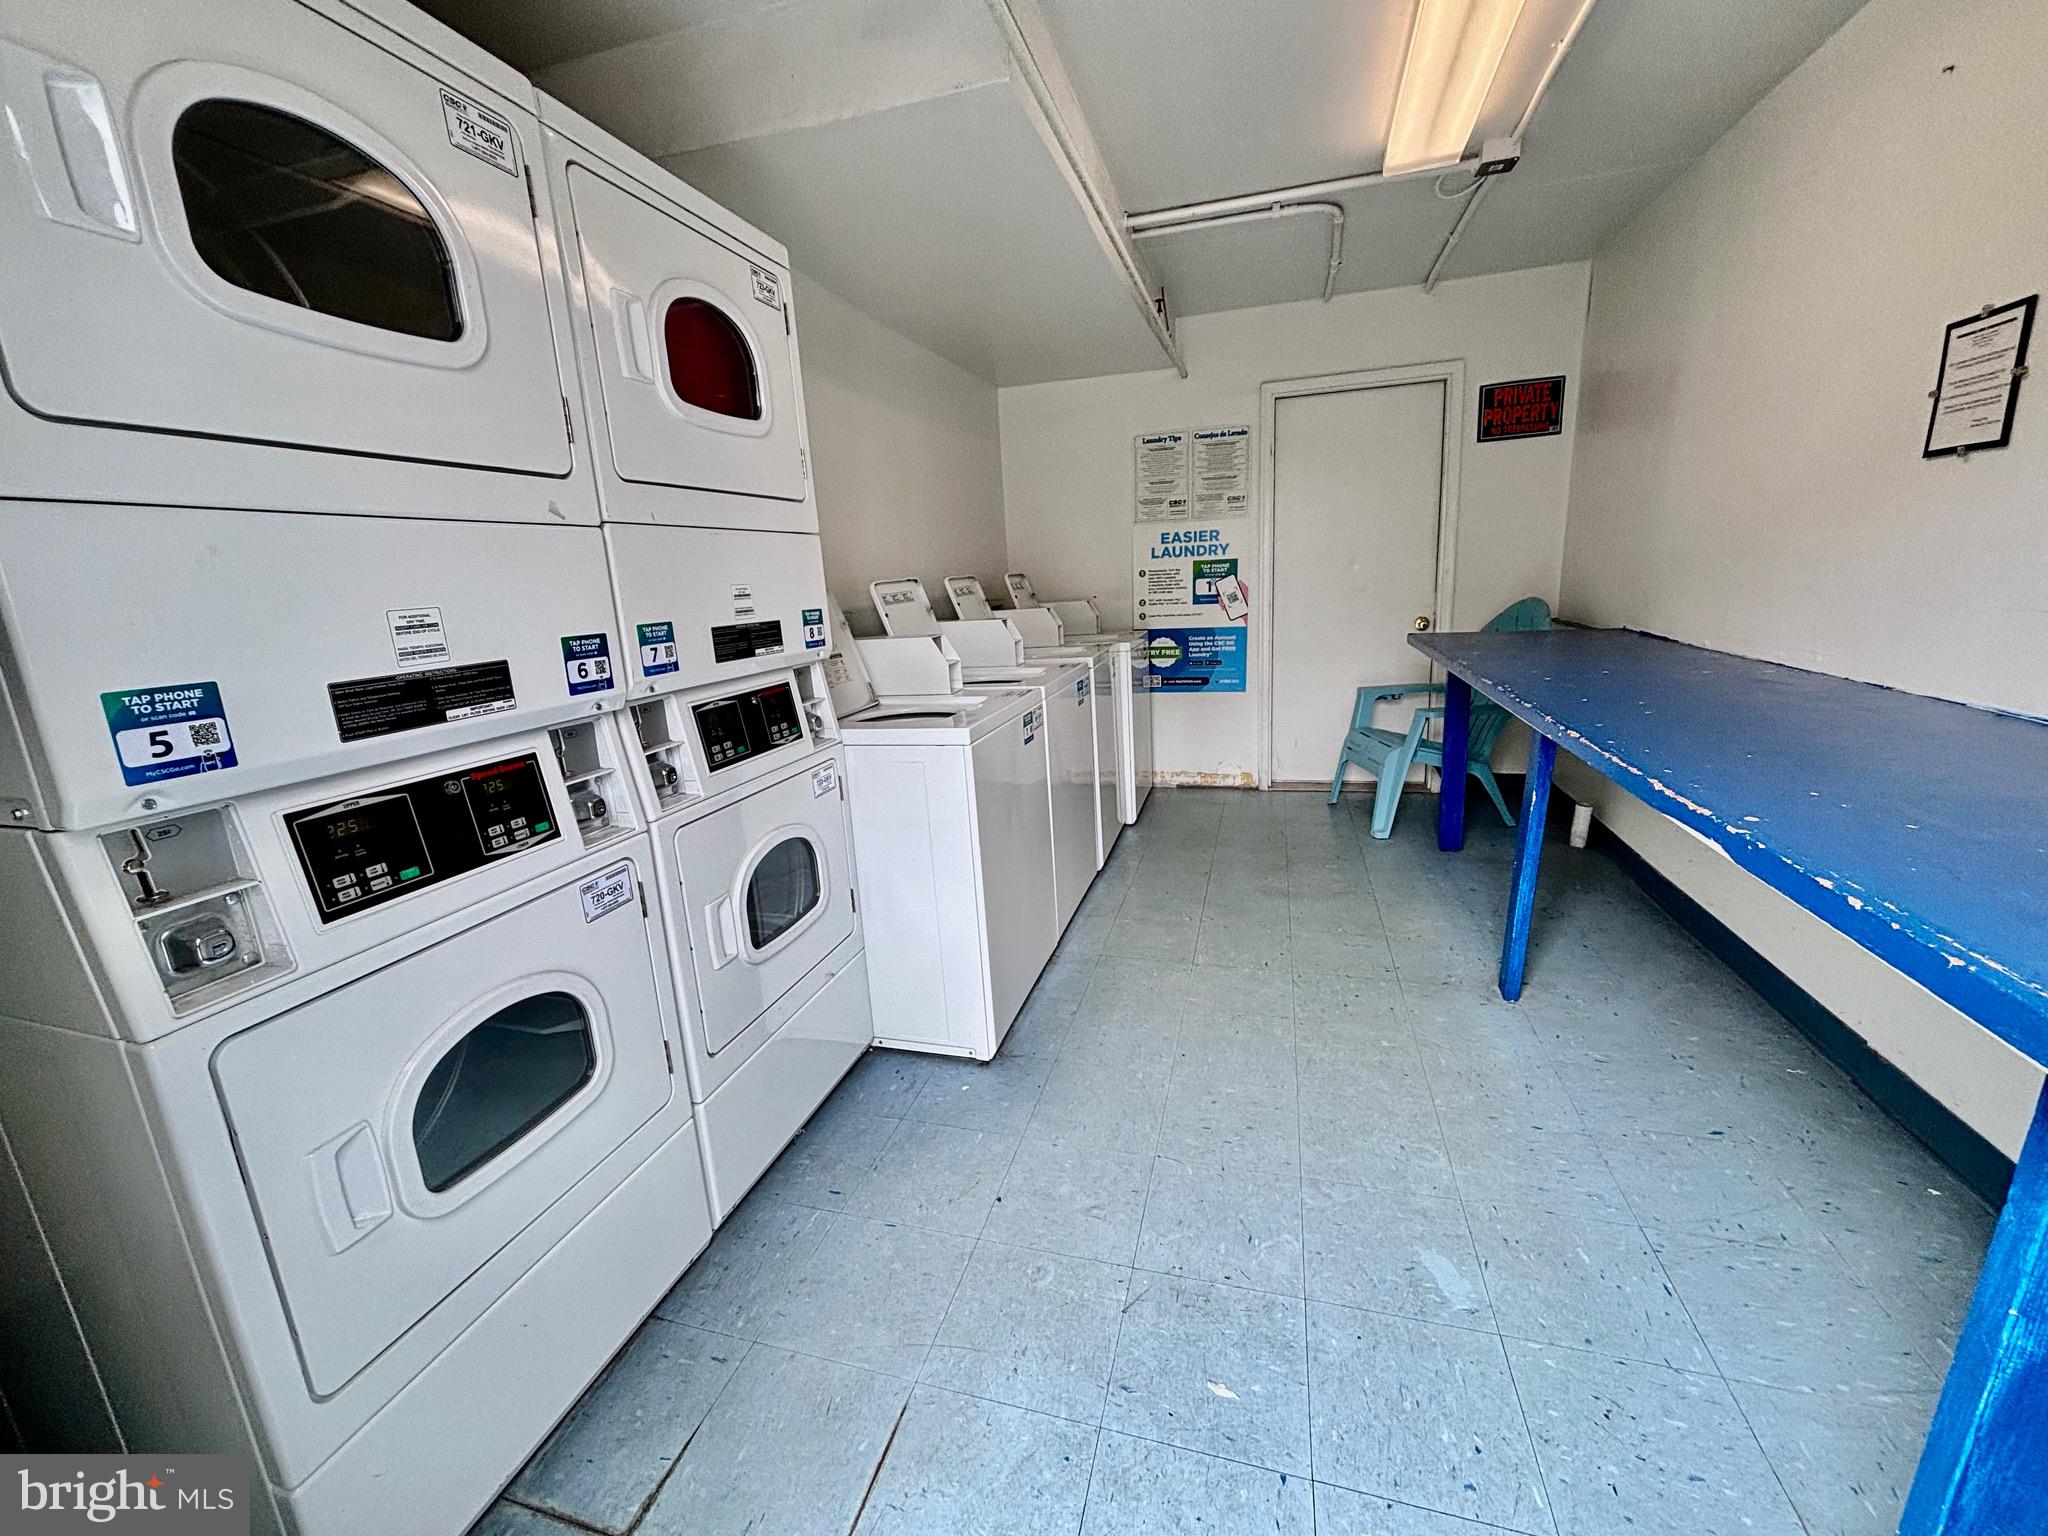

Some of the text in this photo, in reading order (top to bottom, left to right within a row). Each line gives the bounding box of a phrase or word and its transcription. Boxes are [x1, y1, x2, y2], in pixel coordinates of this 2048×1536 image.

[456, 116, 504, 151] 721-GKV
[1494, 383, 1552, 407] PRIVATE
[1484, 400, 1559, 426] PROPERTY
[1142, 435, 1182, 444] Laundry Tips
[1194, 432, 1219, 440] Consejos
[1227, 429, 1248, 437] Lavado
[1160, 529, 1220, 544] EASIER
[1151, 543, 1230, 559] LAUNDRY
[809, 627, 815, 639] 8
[650, 647, 658, 663] 7
[577, 662, 589, 679] 6
[121, 689, 204, 706] TAP PHONE
[130, 698, 200, 715] TO START
[148, 730, 174, 758] 5
[342, 801, 361, 809] UPPER
[590, 881, 624, 905] 720-GKV
